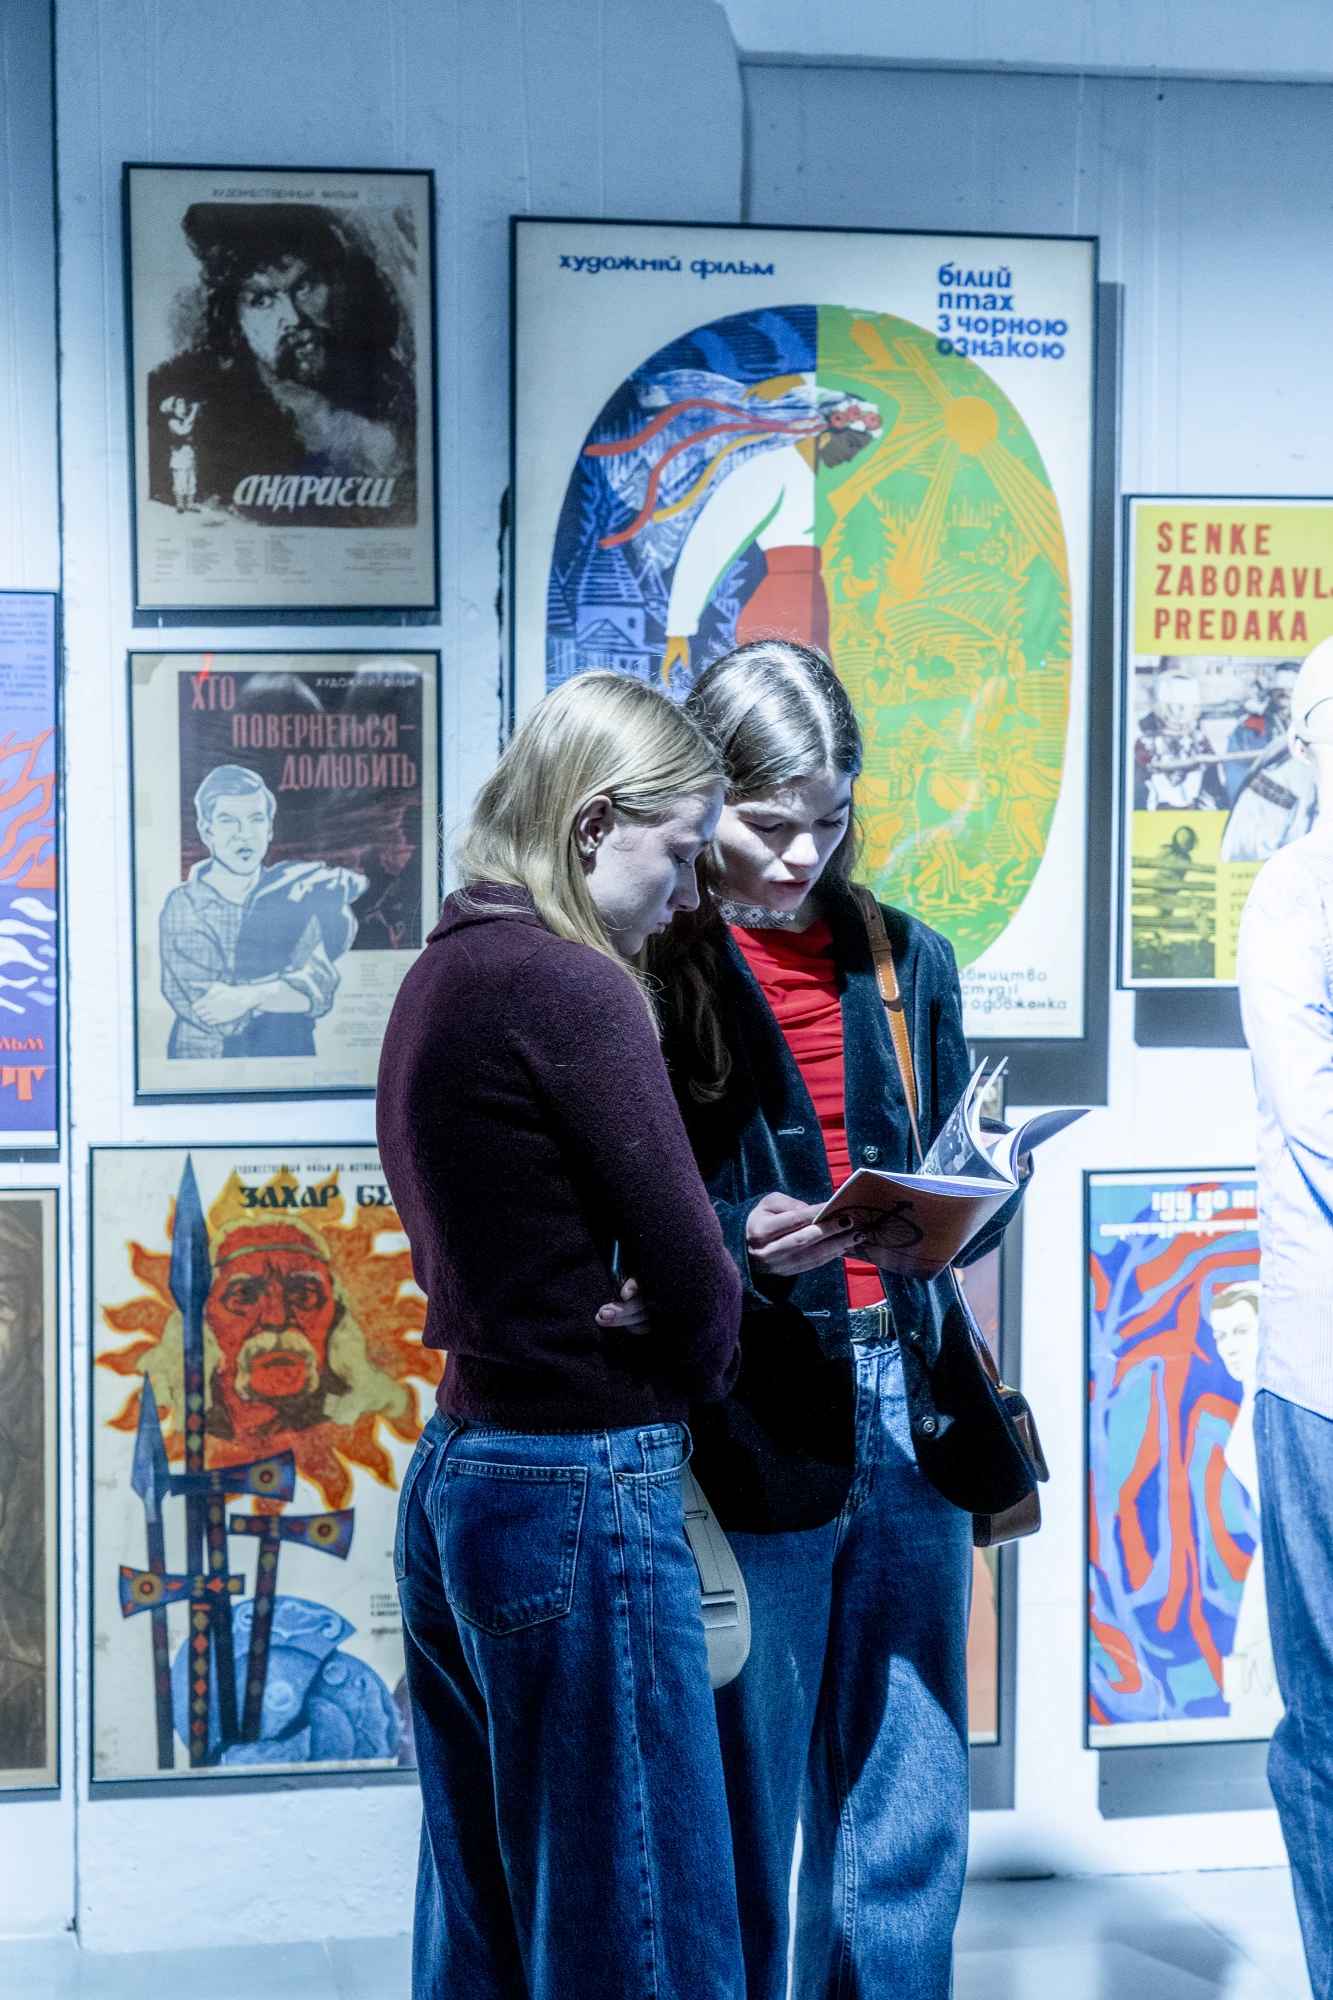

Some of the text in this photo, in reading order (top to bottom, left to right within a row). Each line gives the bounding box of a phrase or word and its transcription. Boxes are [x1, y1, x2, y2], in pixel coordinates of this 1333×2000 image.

[559, 254, 775, 280] художній фільм
[938, 261, 1012, 288] білий
[938, 291, 1013, 312] птах
[957, 315, 1068, 338] чорною
[936, 336, 1066, 360] ознакою
[1157, 521, 1271, 556] SENKE
[1154, 608, 1308, 641] PREDAKA
[190, 675, 236, 711] ХТО
[278, 752, 418, 791] ДОЛЮБИТЬ
[238, 1184, 393, 1208] ЗАХАР БЕ
